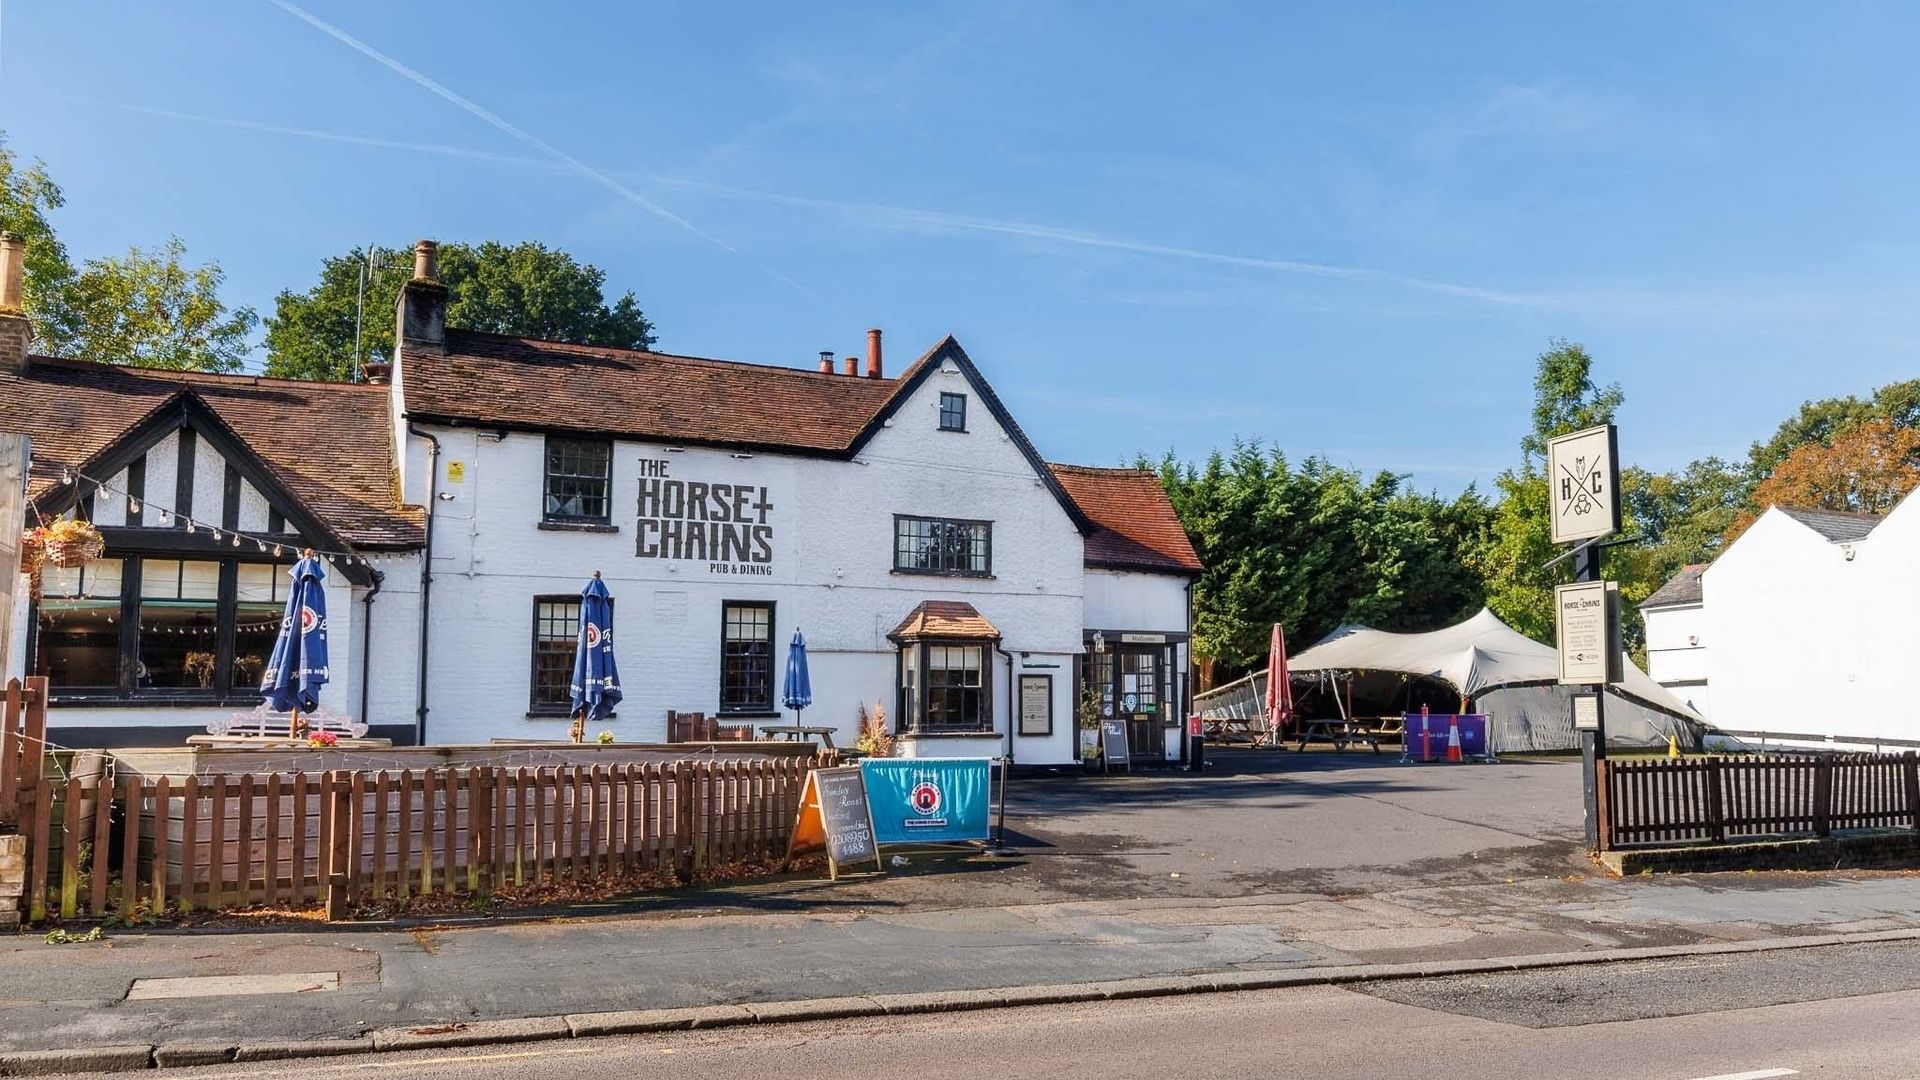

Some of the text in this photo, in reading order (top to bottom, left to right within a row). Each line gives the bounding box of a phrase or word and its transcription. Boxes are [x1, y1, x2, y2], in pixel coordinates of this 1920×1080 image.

[638, 458, 670, 478] THE
[1561, 471, 1602, 501] H C
[635, 518, 773, 563] CHAINS
[710, 563, 773, 576] PUB & DINING
